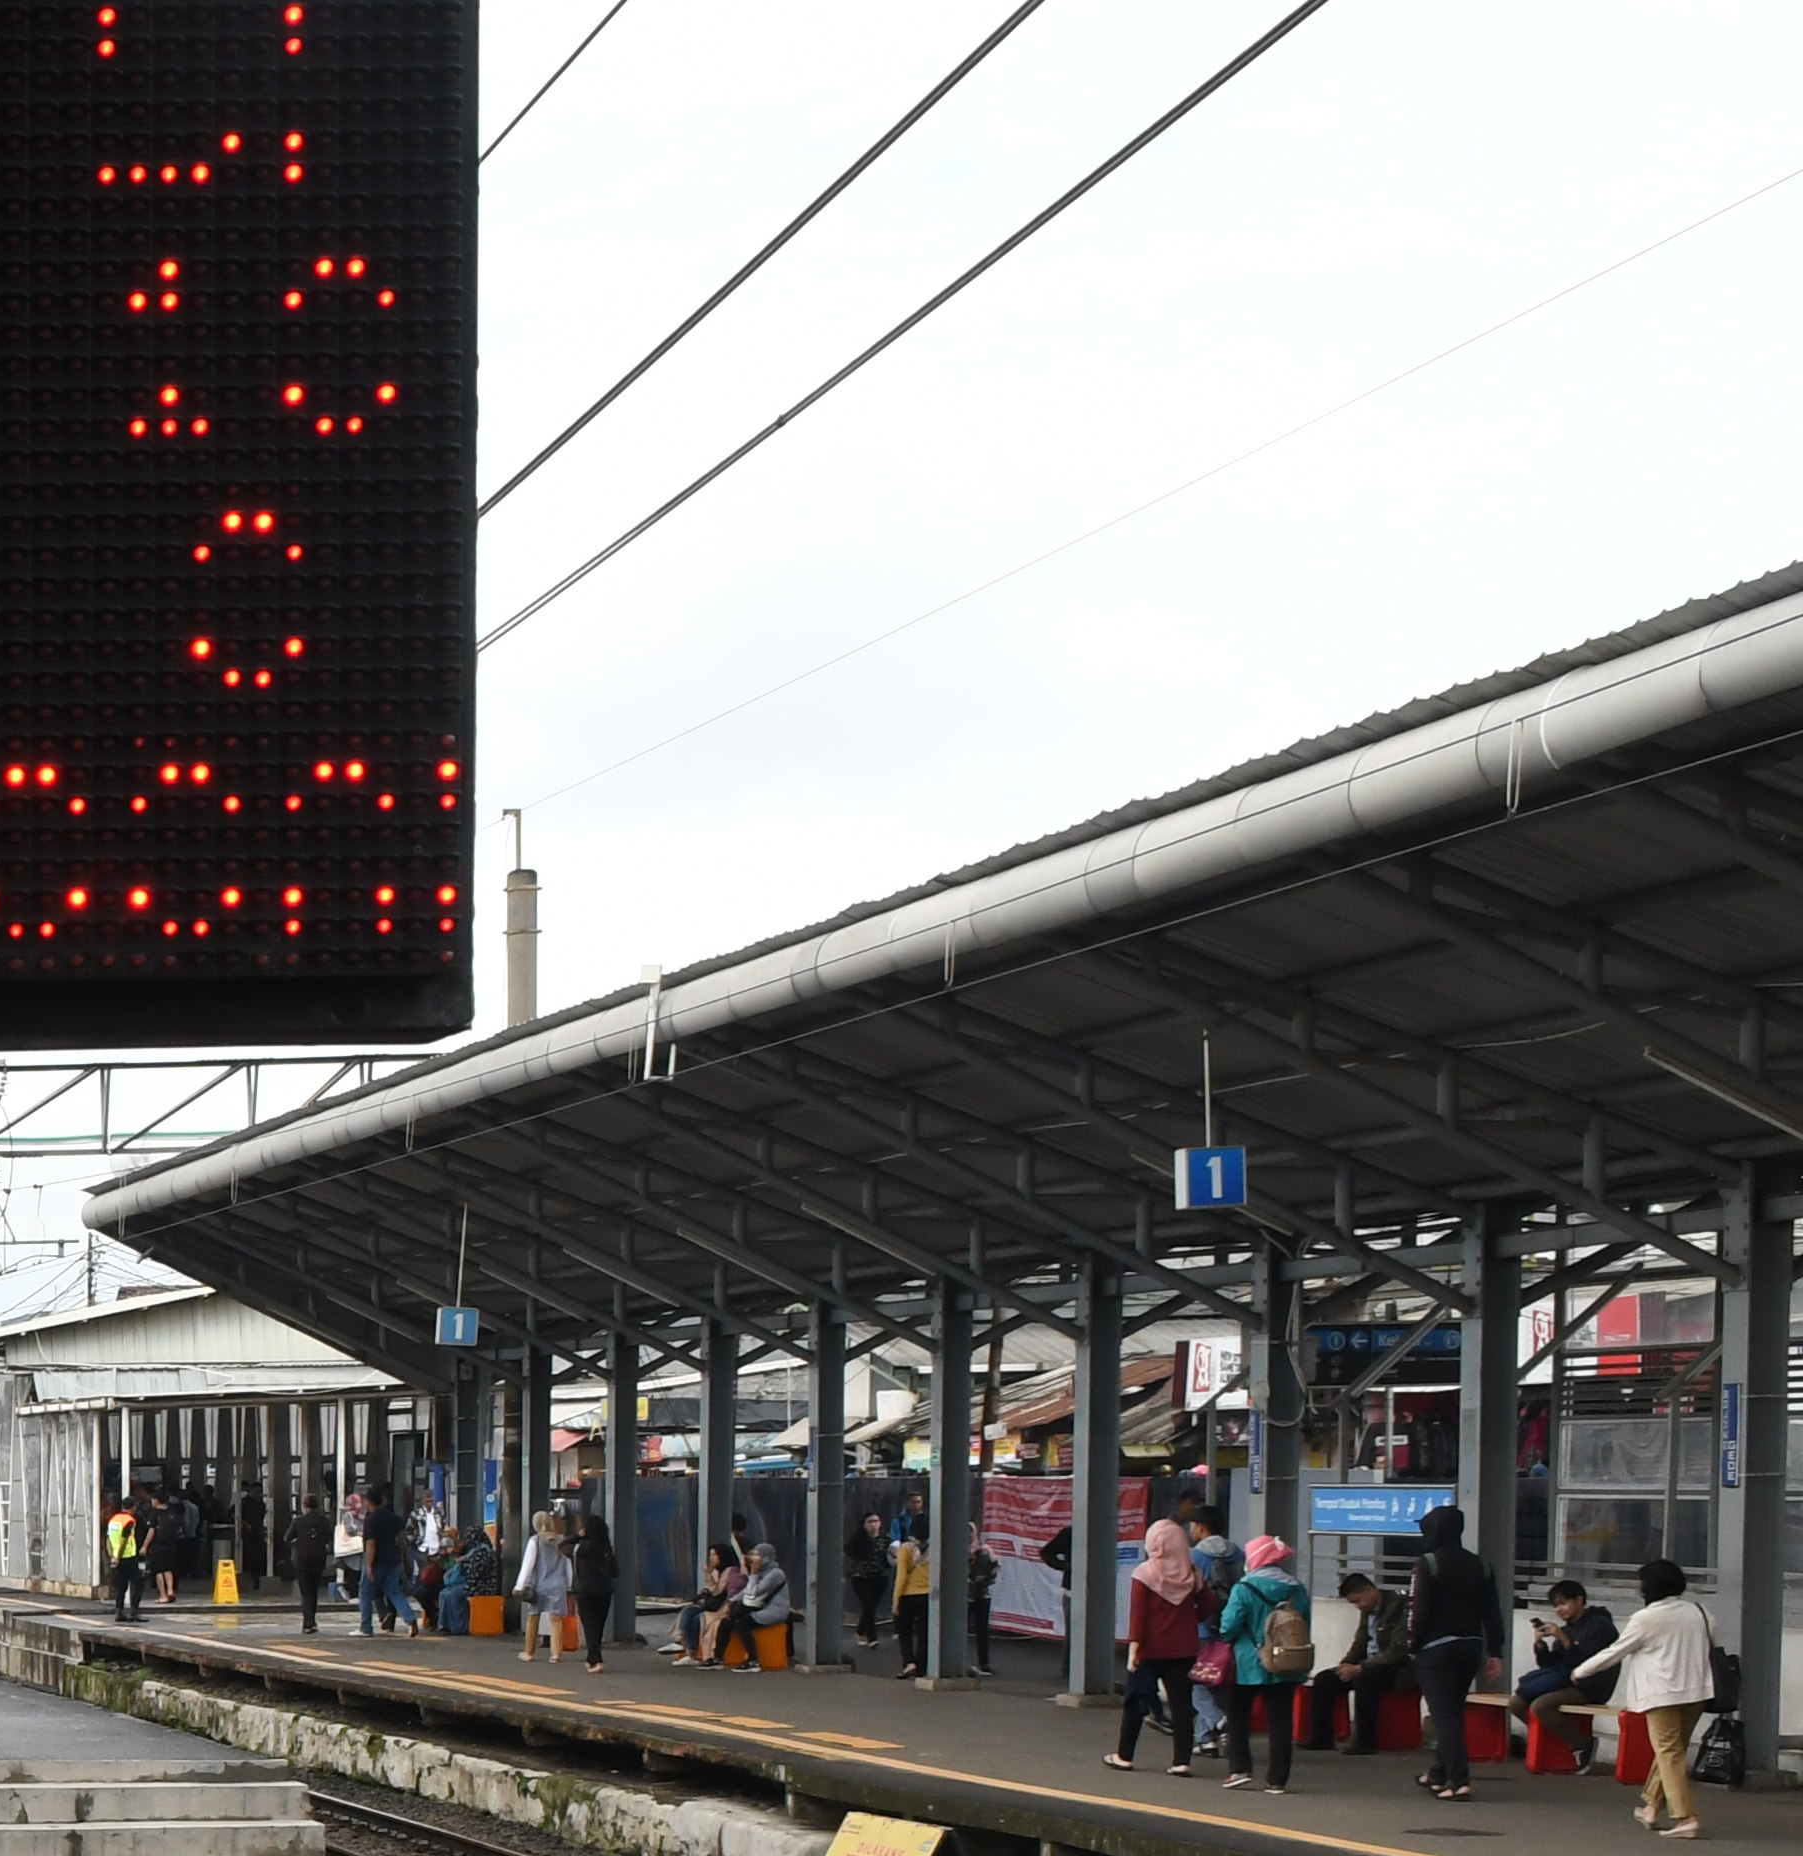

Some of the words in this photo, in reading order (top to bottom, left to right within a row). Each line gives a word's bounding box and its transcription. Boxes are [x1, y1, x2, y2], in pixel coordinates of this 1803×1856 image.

[1205, 1155, 1223, 1199] 1
[452, 1312, 464, 1340] 1
[1727, 1440, 1737, 1481] GEDE
